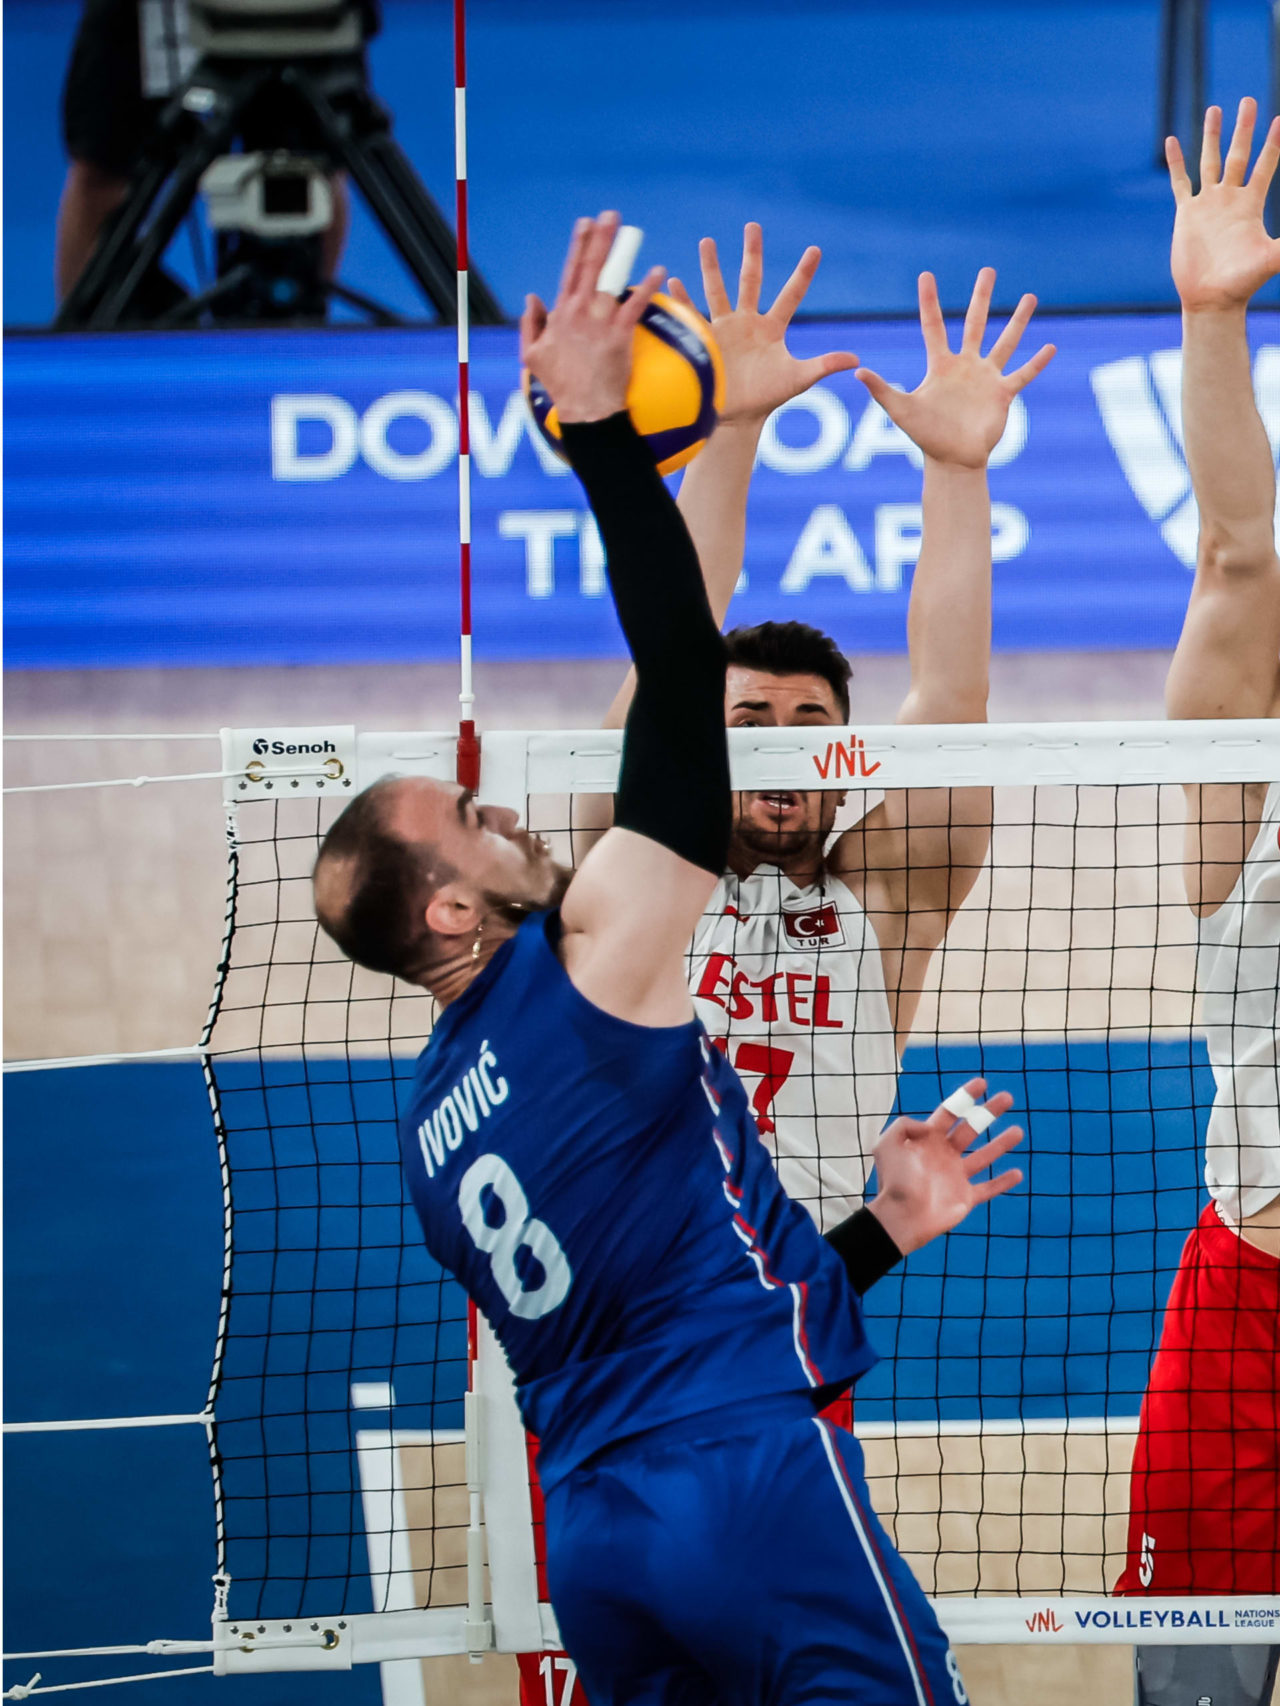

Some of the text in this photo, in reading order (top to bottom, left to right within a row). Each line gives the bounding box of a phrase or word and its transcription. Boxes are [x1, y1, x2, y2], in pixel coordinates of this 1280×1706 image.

[271, 383, 1030, 481] DOWOA
[779, 502, 1033, 595] APP
[271, 740, 336, 755] Senoh
[812, 734, 881, 779] VNL
[797, 937, 830, 947] TUR
[696, 952, 843, 1028] ESTEL
[418, 1040, 509, 1178] IVOVIĆ
[711, 1037, 795, 1135] 7
[458, 1153, 573, 1320] 8
[1139, 1531, 1156, 1588] 5
[1025, 1608, 1280, 1632] VNL VOLLEYBALL NATIONS
[1234, 1619, 1275, 1627] LEAGUE
[539, 1656, 577, 1706] 17
